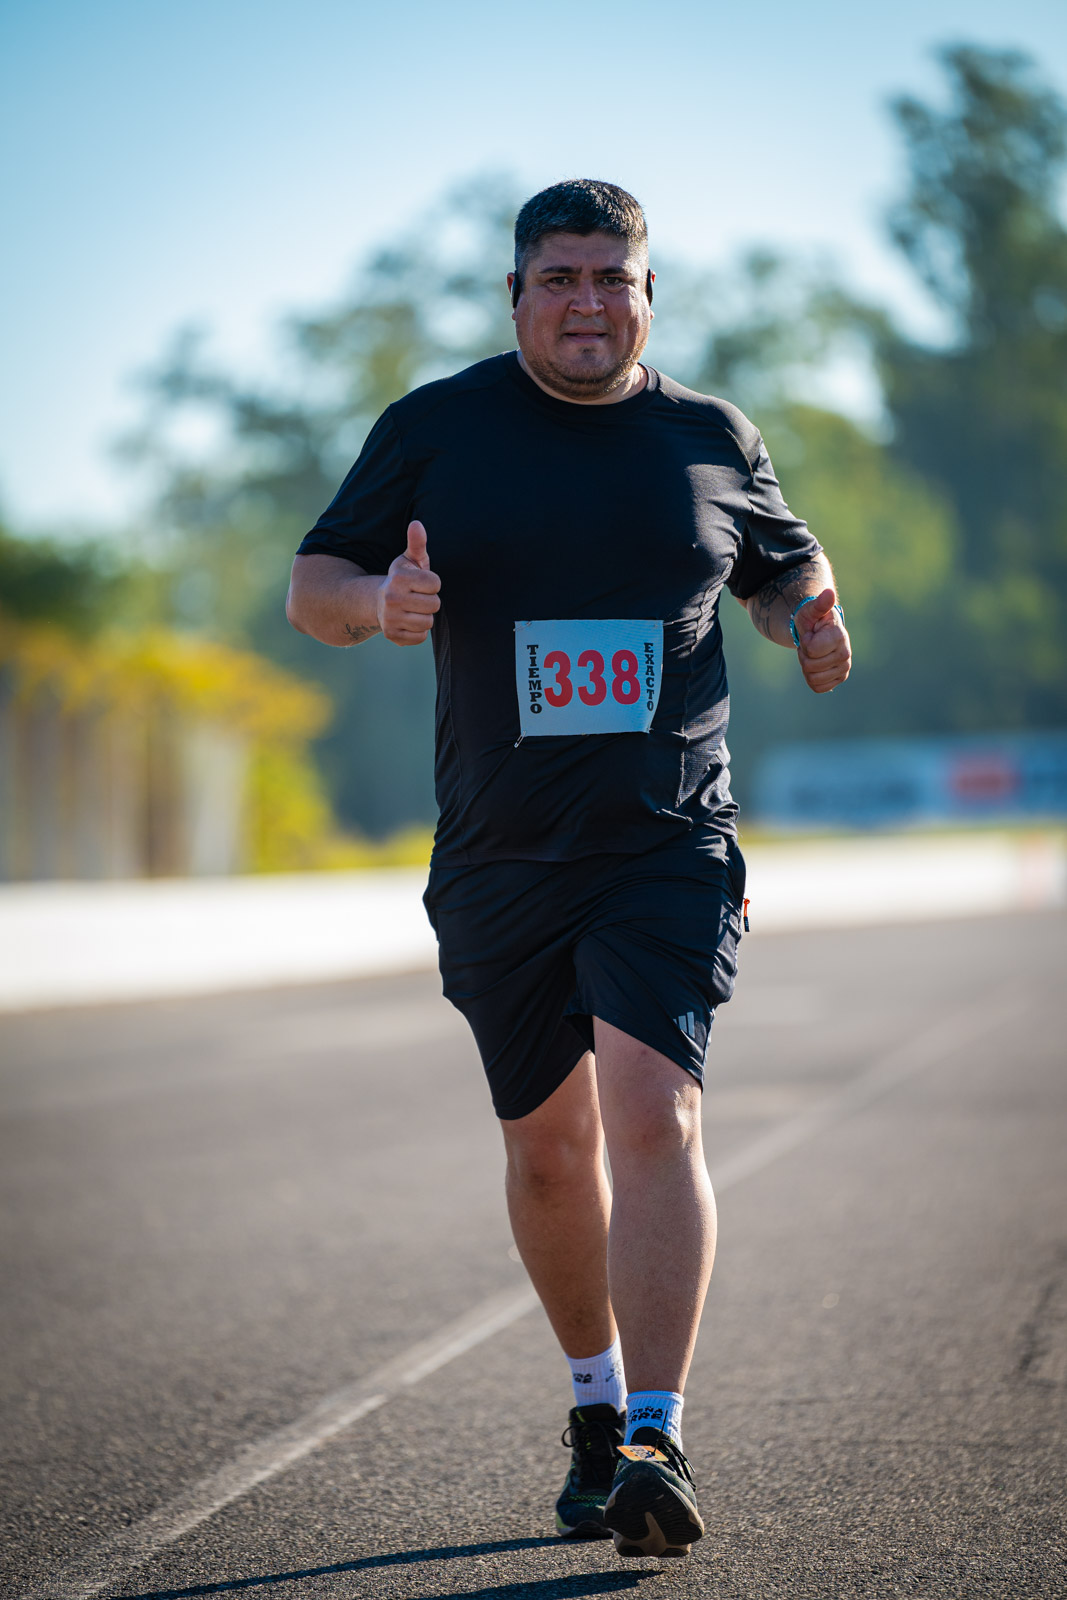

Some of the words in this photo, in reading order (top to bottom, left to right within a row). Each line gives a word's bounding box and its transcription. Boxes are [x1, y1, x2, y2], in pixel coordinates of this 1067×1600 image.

[526, 644, 543, 715] TIEMPO
[543, 649, 641, 708] 338
[643, 642, 655, 712] EXACTO
